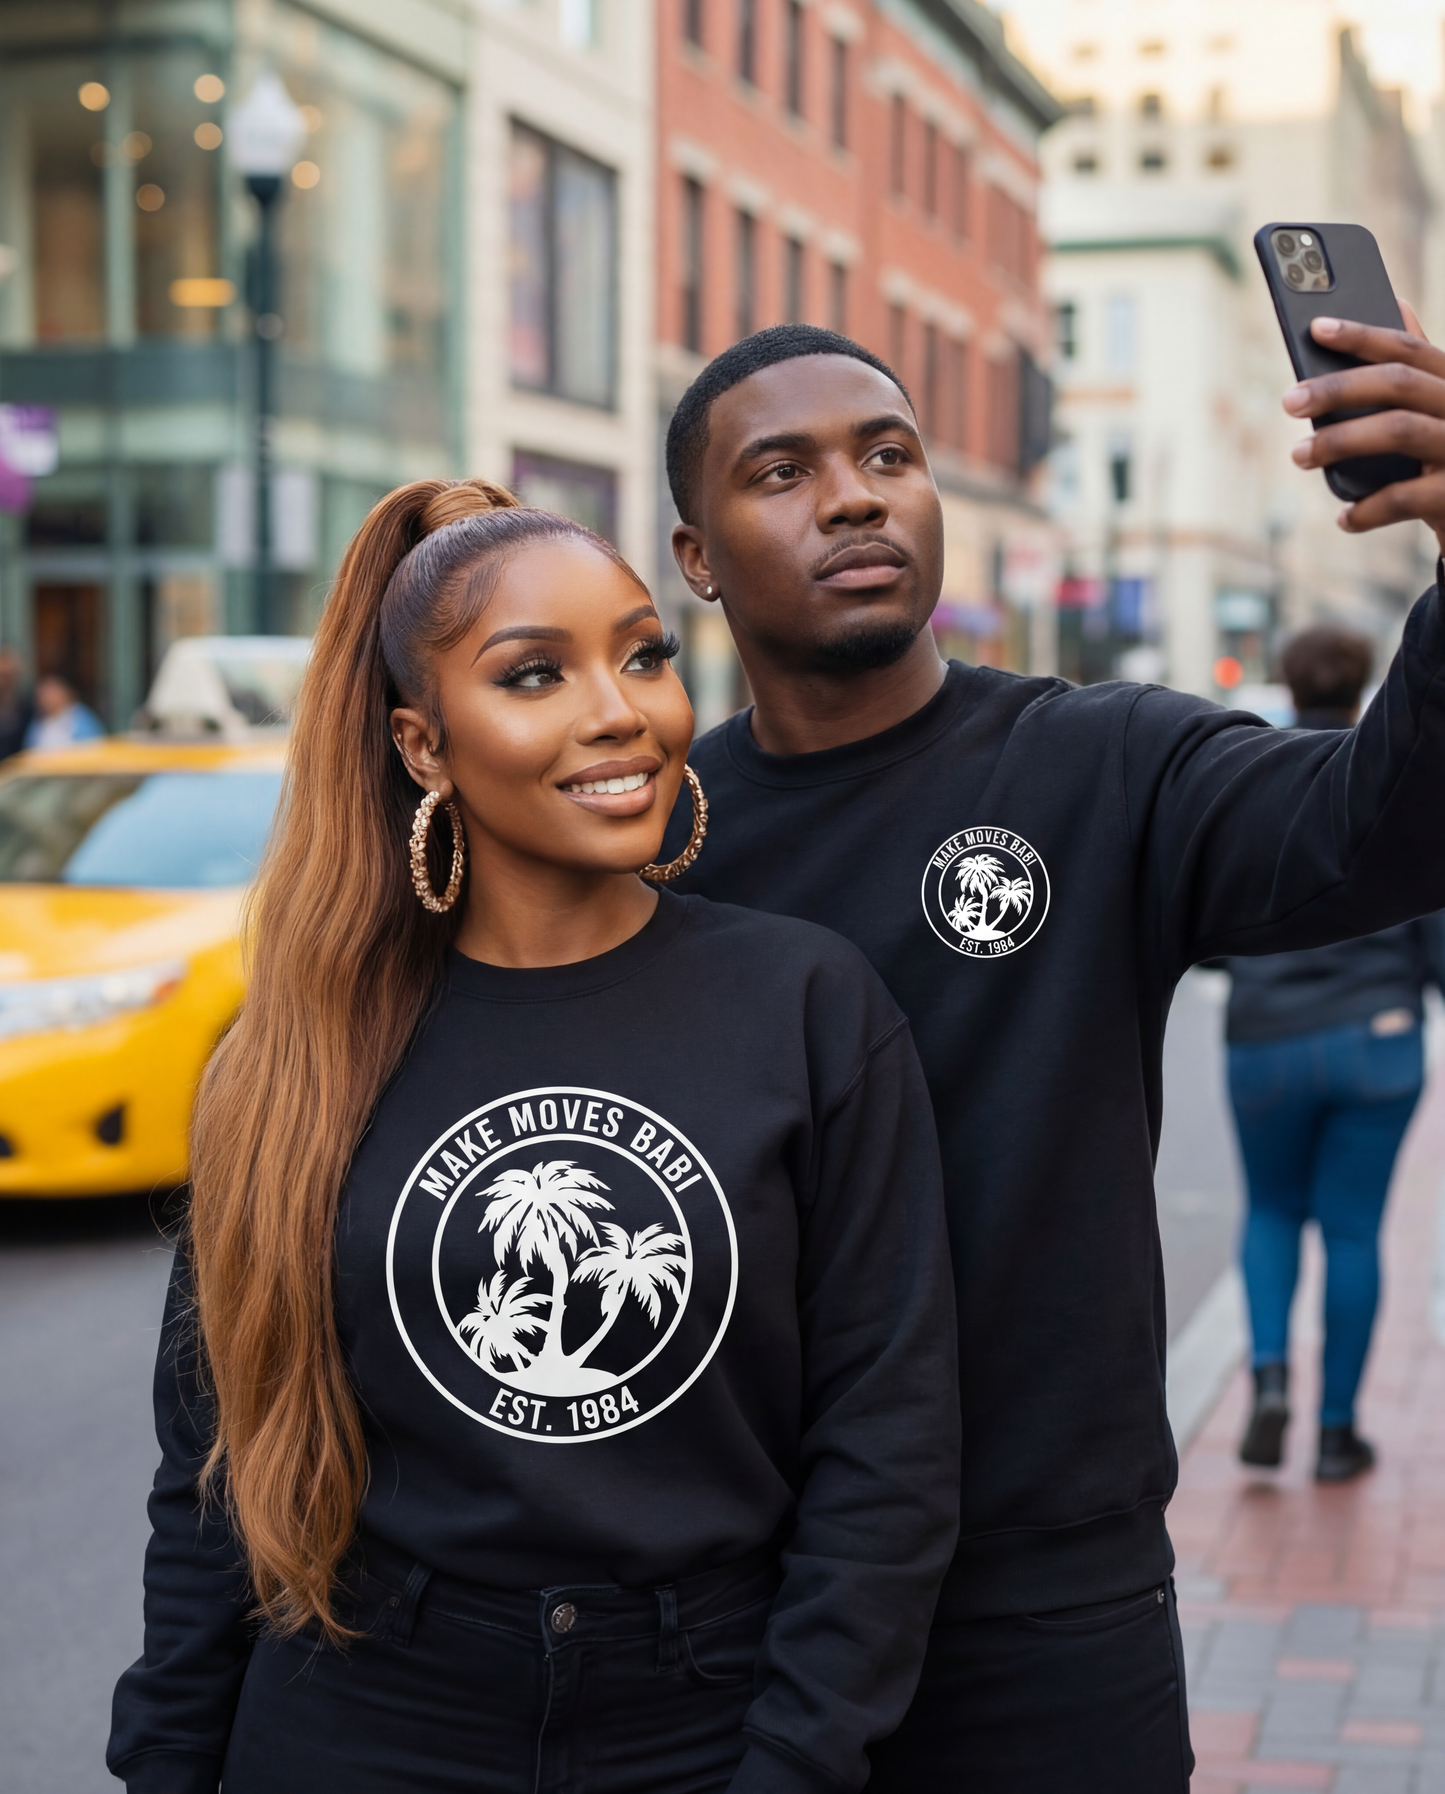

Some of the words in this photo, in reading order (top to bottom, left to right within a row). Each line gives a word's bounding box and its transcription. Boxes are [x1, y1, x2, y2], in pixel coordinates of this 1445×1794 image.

[932, 837, 964, 870] MAKE
[965, 830, 1008, 846] MOVES
[1010, 838, 1037, 866] BABI
[959, 937, 983, 954] EST.
[988, 936, 1015, 954] 1984
[418, 1117, 502, 1201] MAKE
[507, 1099, 624, 1137] MOVES
[630, 1121, 702, 1193] BABI
[488, 1387, 552, 1431] EST.
[566, 1385, 640, 1431] 1984
